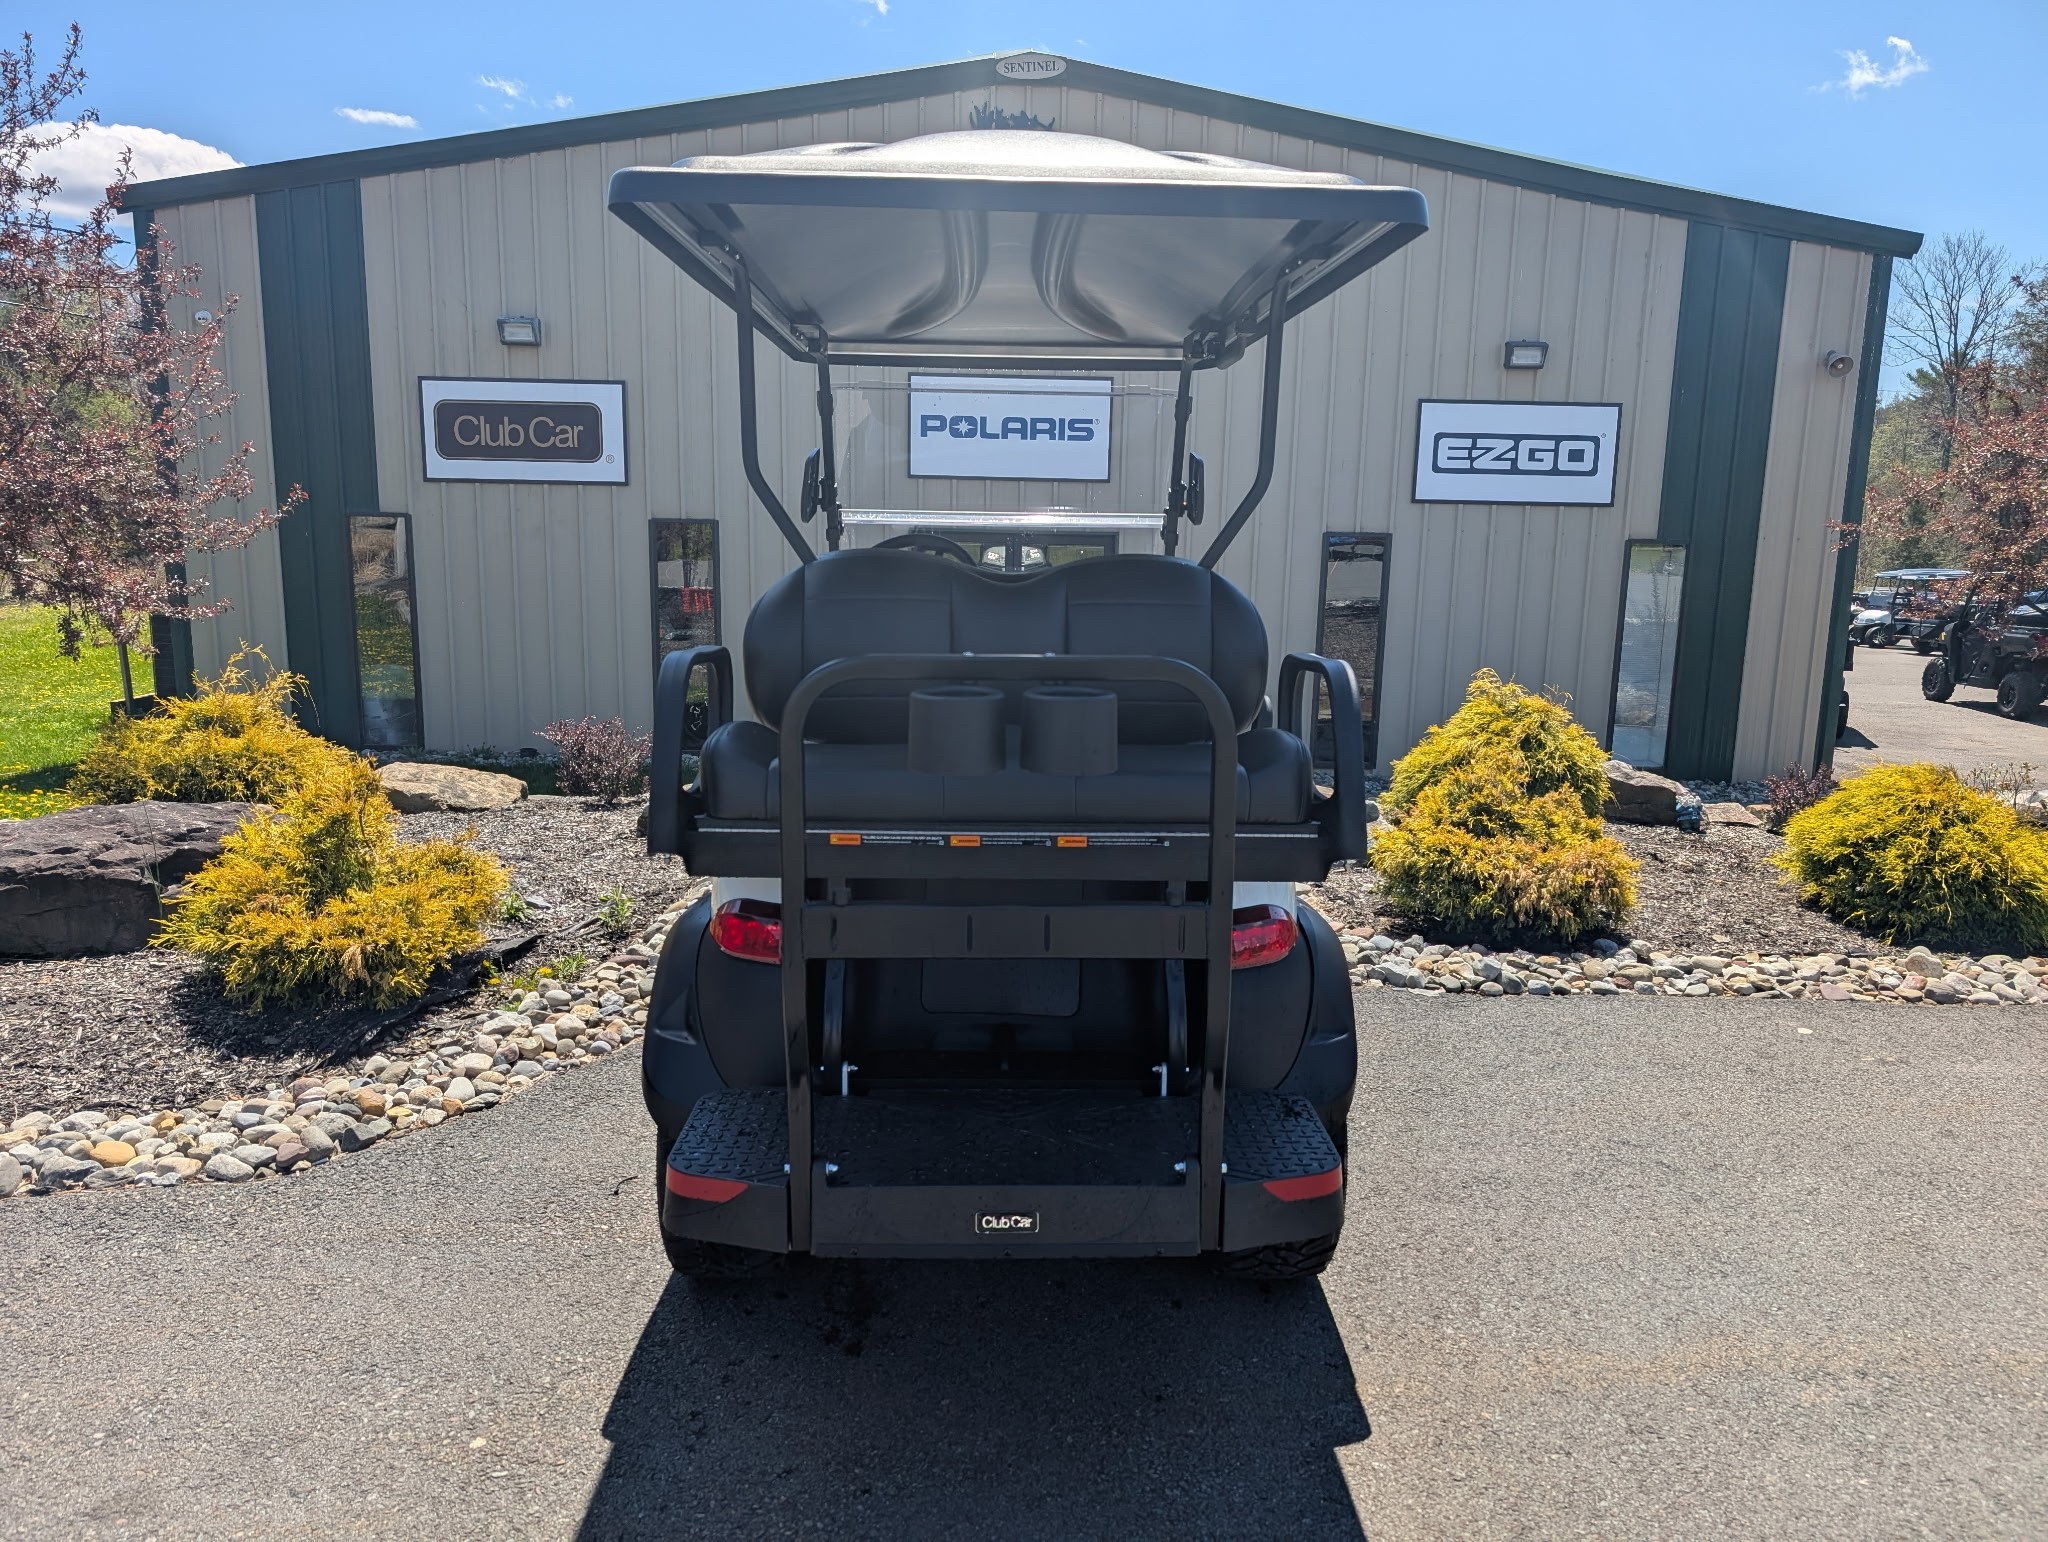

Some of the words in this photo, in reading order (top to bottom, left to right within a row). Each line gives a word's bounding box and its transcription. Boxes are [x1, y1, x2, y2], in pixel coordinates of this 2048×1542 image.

[1003, 60, 1060, 74] SENTINEL
[453, 415, 525, 447] Club
[528, 416, 584, 448] Car
[920, 414, 1095, 442] POLARIS
[1437, 437, 1596, 472] EZGO
[982, 1215, 1010, 1229] Club
[1010, 1215, 1033, 1228] Car
